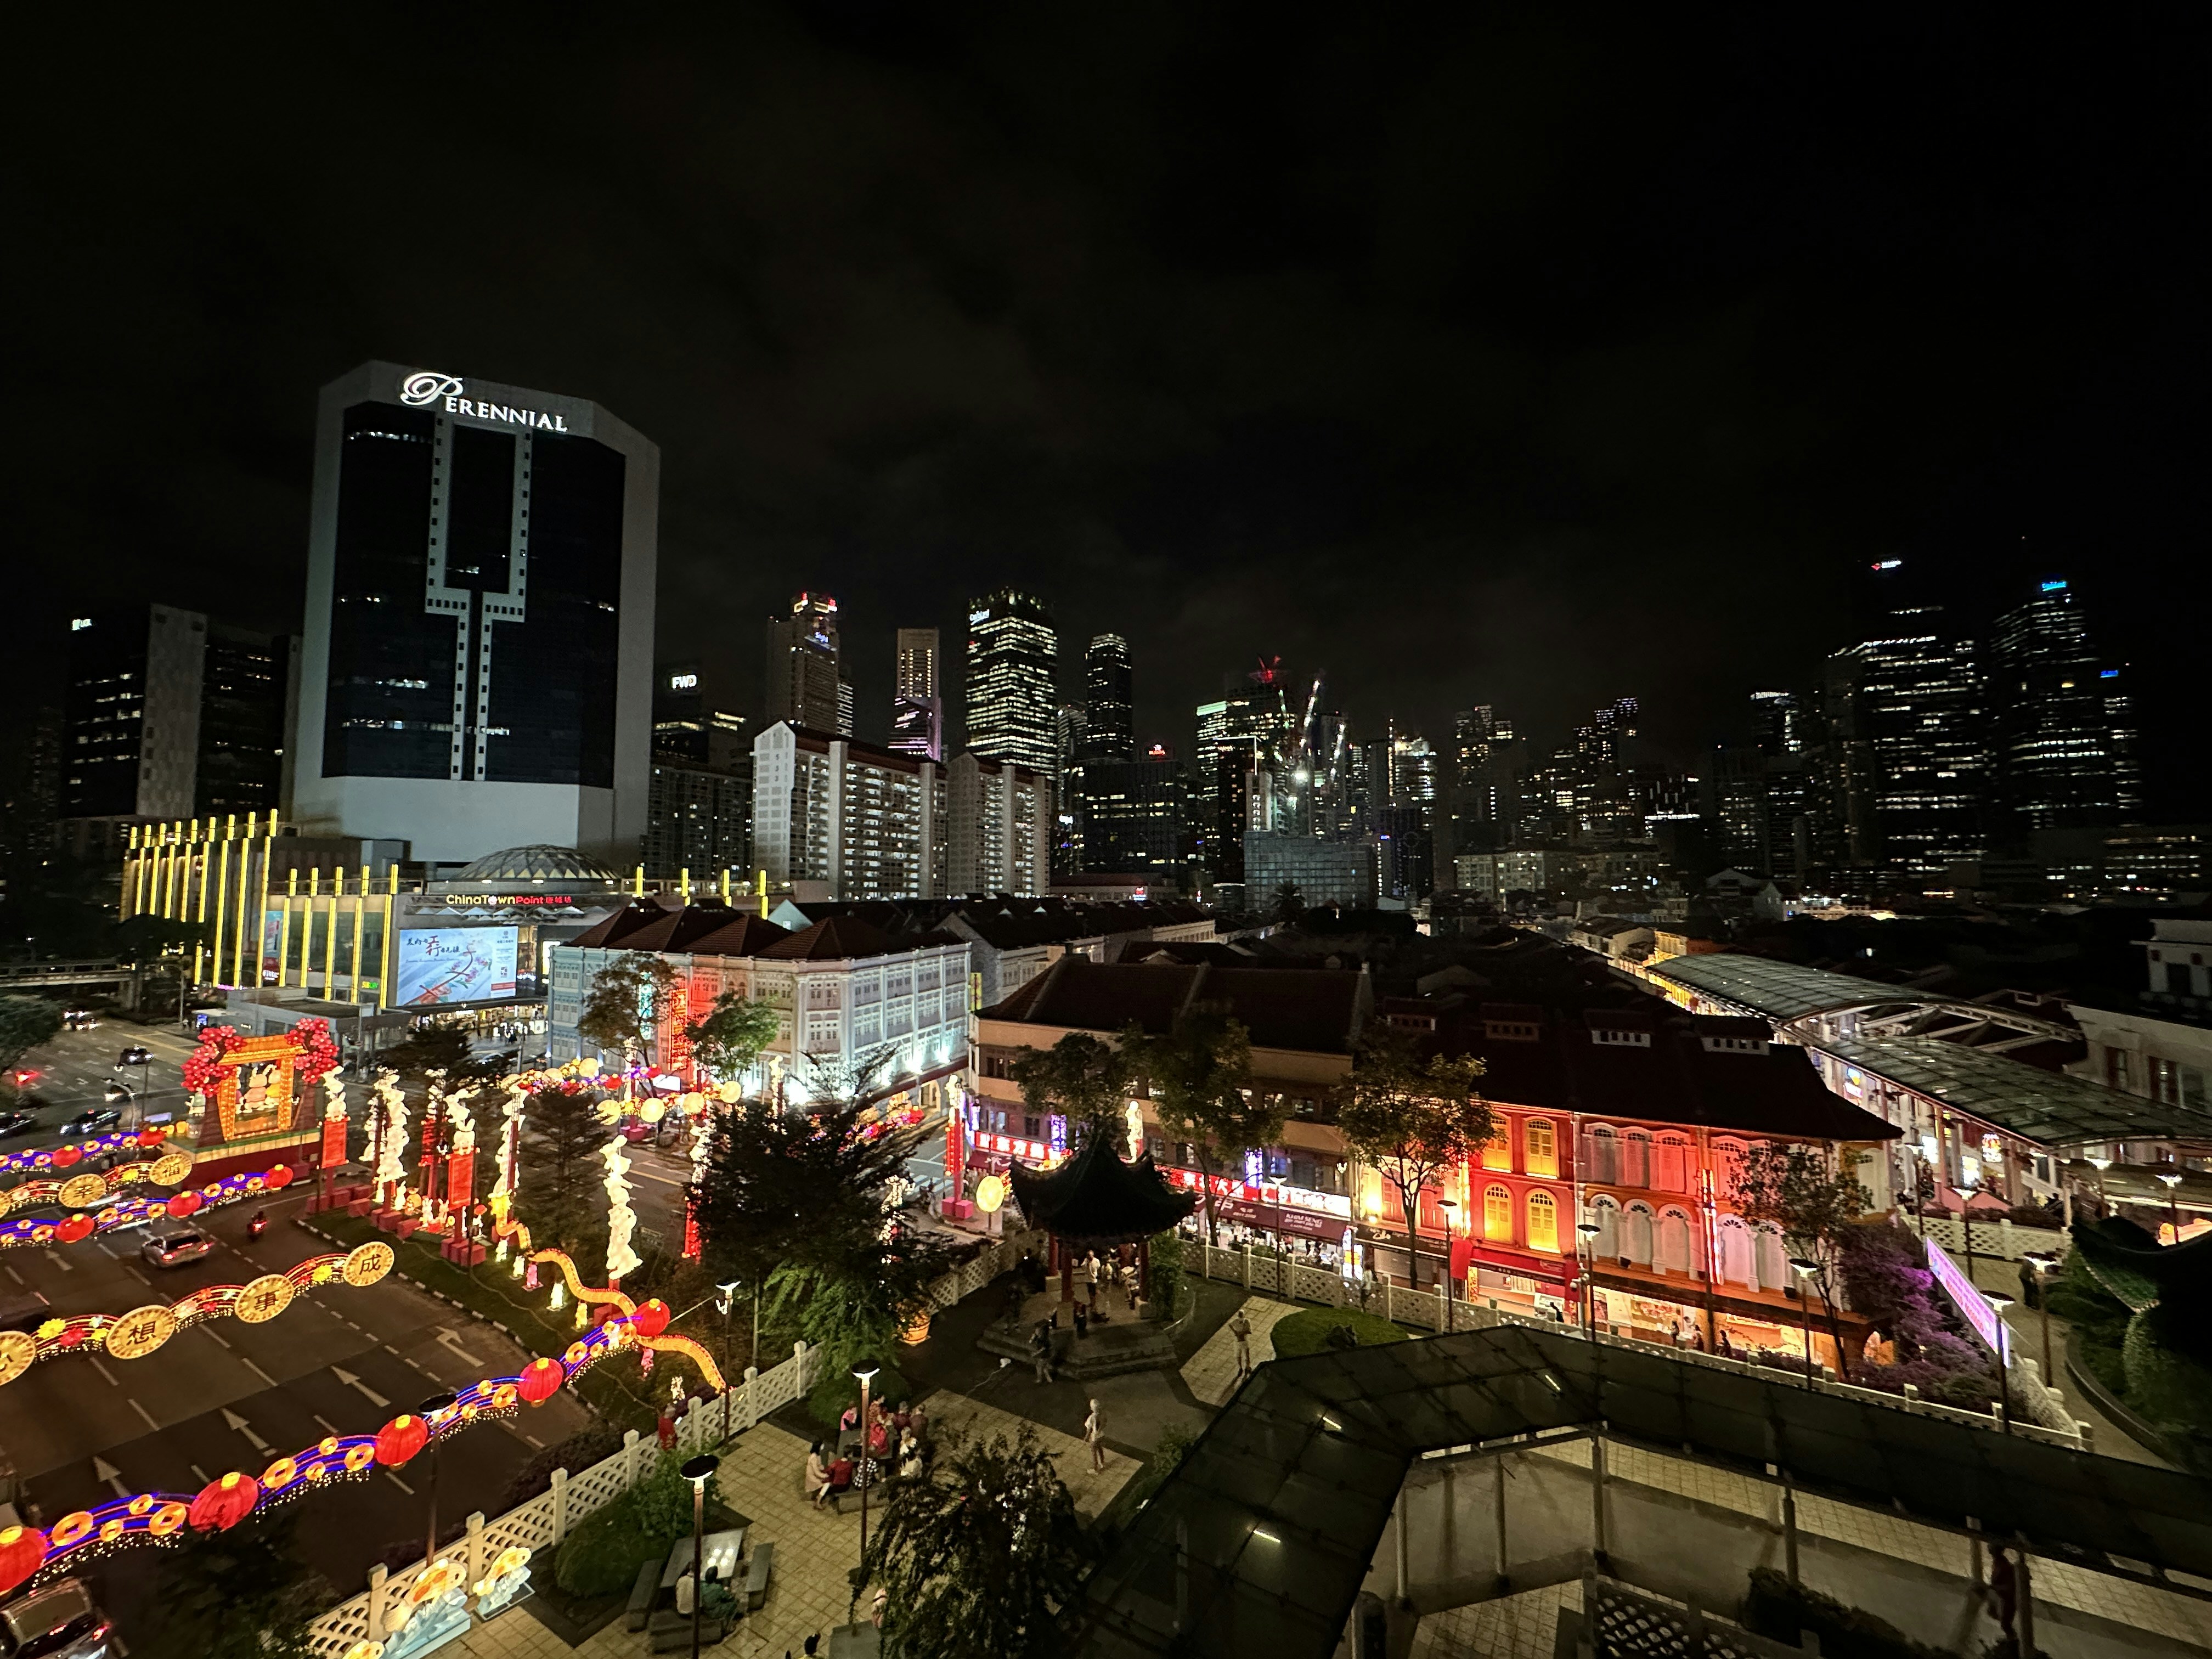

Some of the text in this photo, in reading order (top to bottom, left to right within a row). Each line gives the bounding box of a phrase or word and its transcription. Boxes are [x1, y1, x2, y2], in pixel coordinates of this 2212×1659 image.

[400, 372, 568, 432] PERENNIAL
[672, 674, 697, 690] FWD
[126, 1254, 382, 1346] 想 事 成
